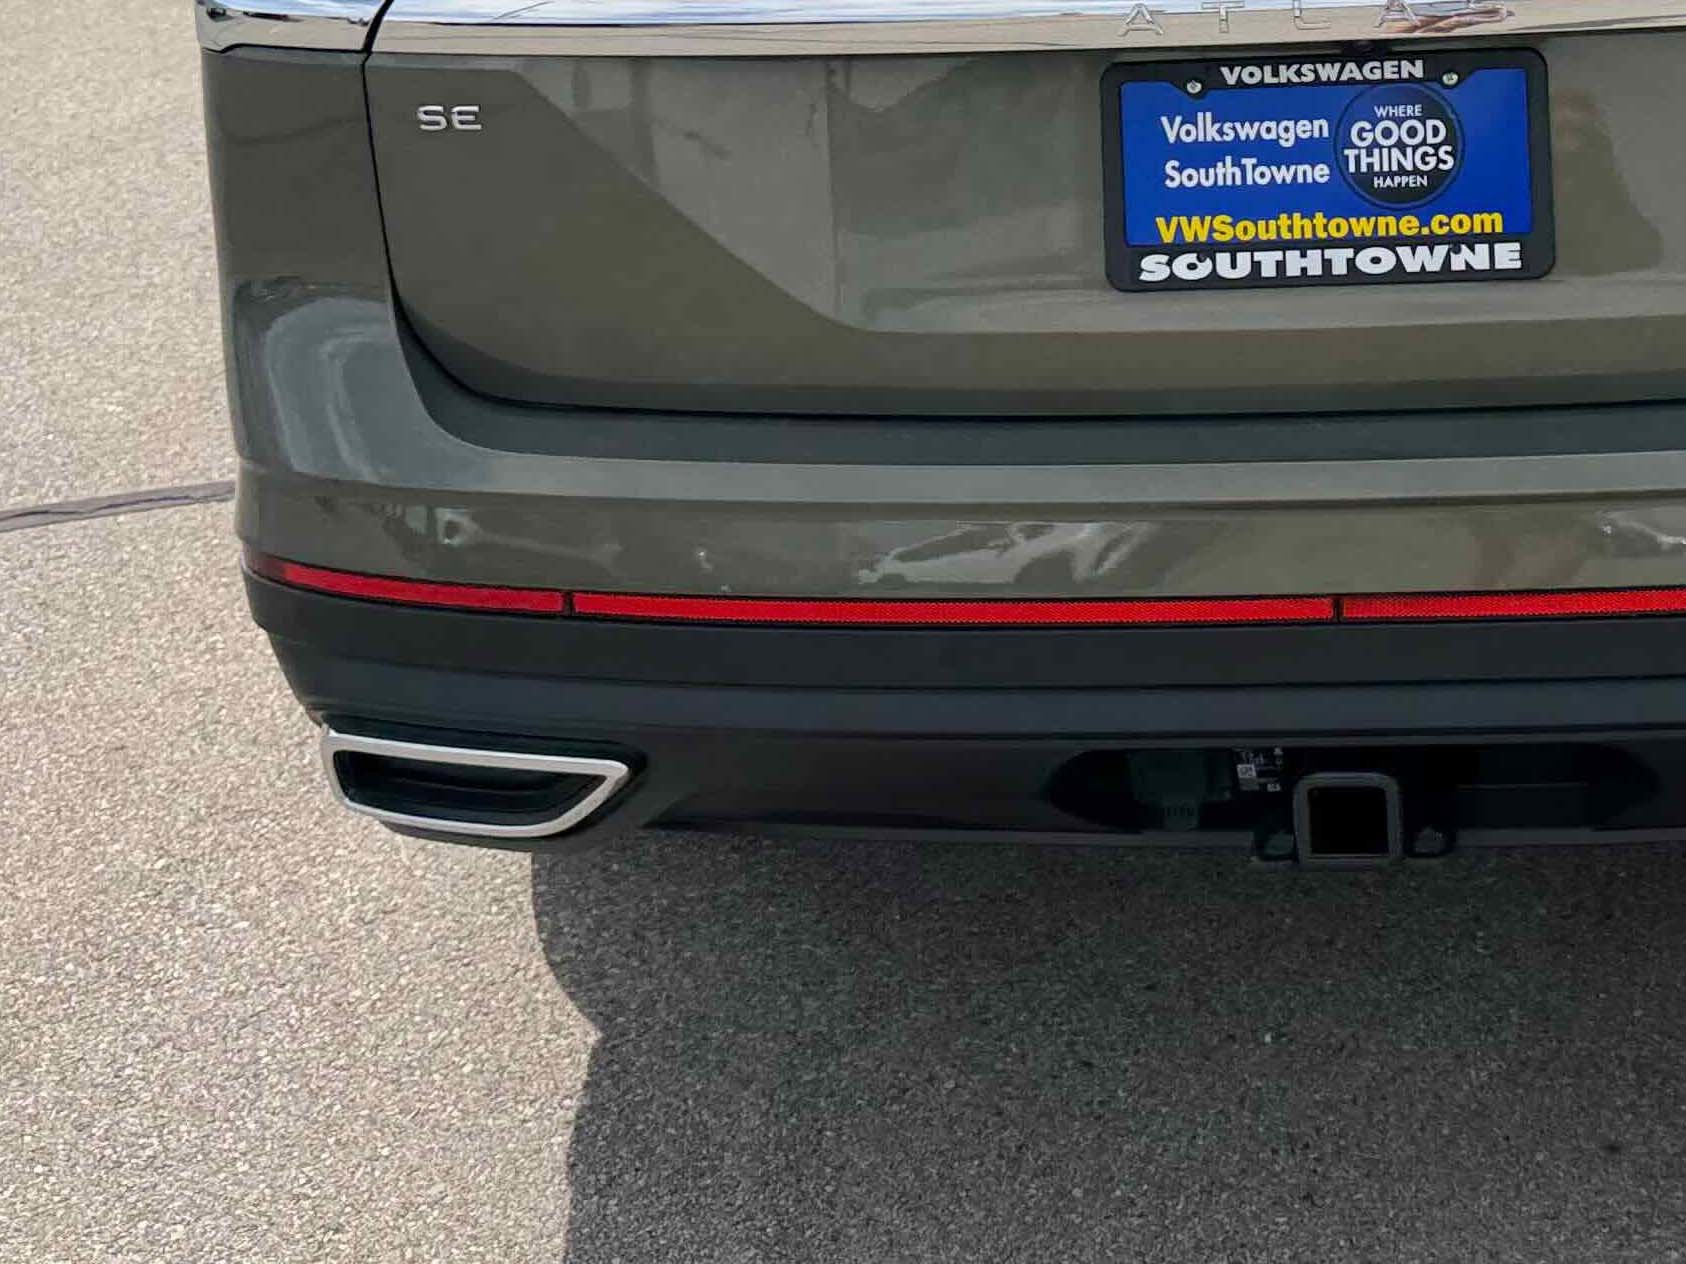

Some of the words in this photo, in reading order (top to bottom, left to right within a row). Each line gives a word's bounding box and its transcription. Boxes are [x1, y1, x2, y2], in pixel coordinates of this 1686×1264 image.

[1220, 59, 1424, 86] VOLKSWAGEN
[417, 105, 482, 130] SE
[1373, 104, 1423, 118] WHERE
[1161, 110, 1329, 148] Volkswagen
[1349, 119, 1447, 148] GOOD
[1164, 158, 1330, 189] SouthTowne
[1343, 144, 1455, 174] THINGS
[1373, 174, 1428, 189] HAPPEN
[1155, 211, 1504, 244] VWSouthtowne.com
[1138, 242, 1522, 282] SOUTHTOWNE
